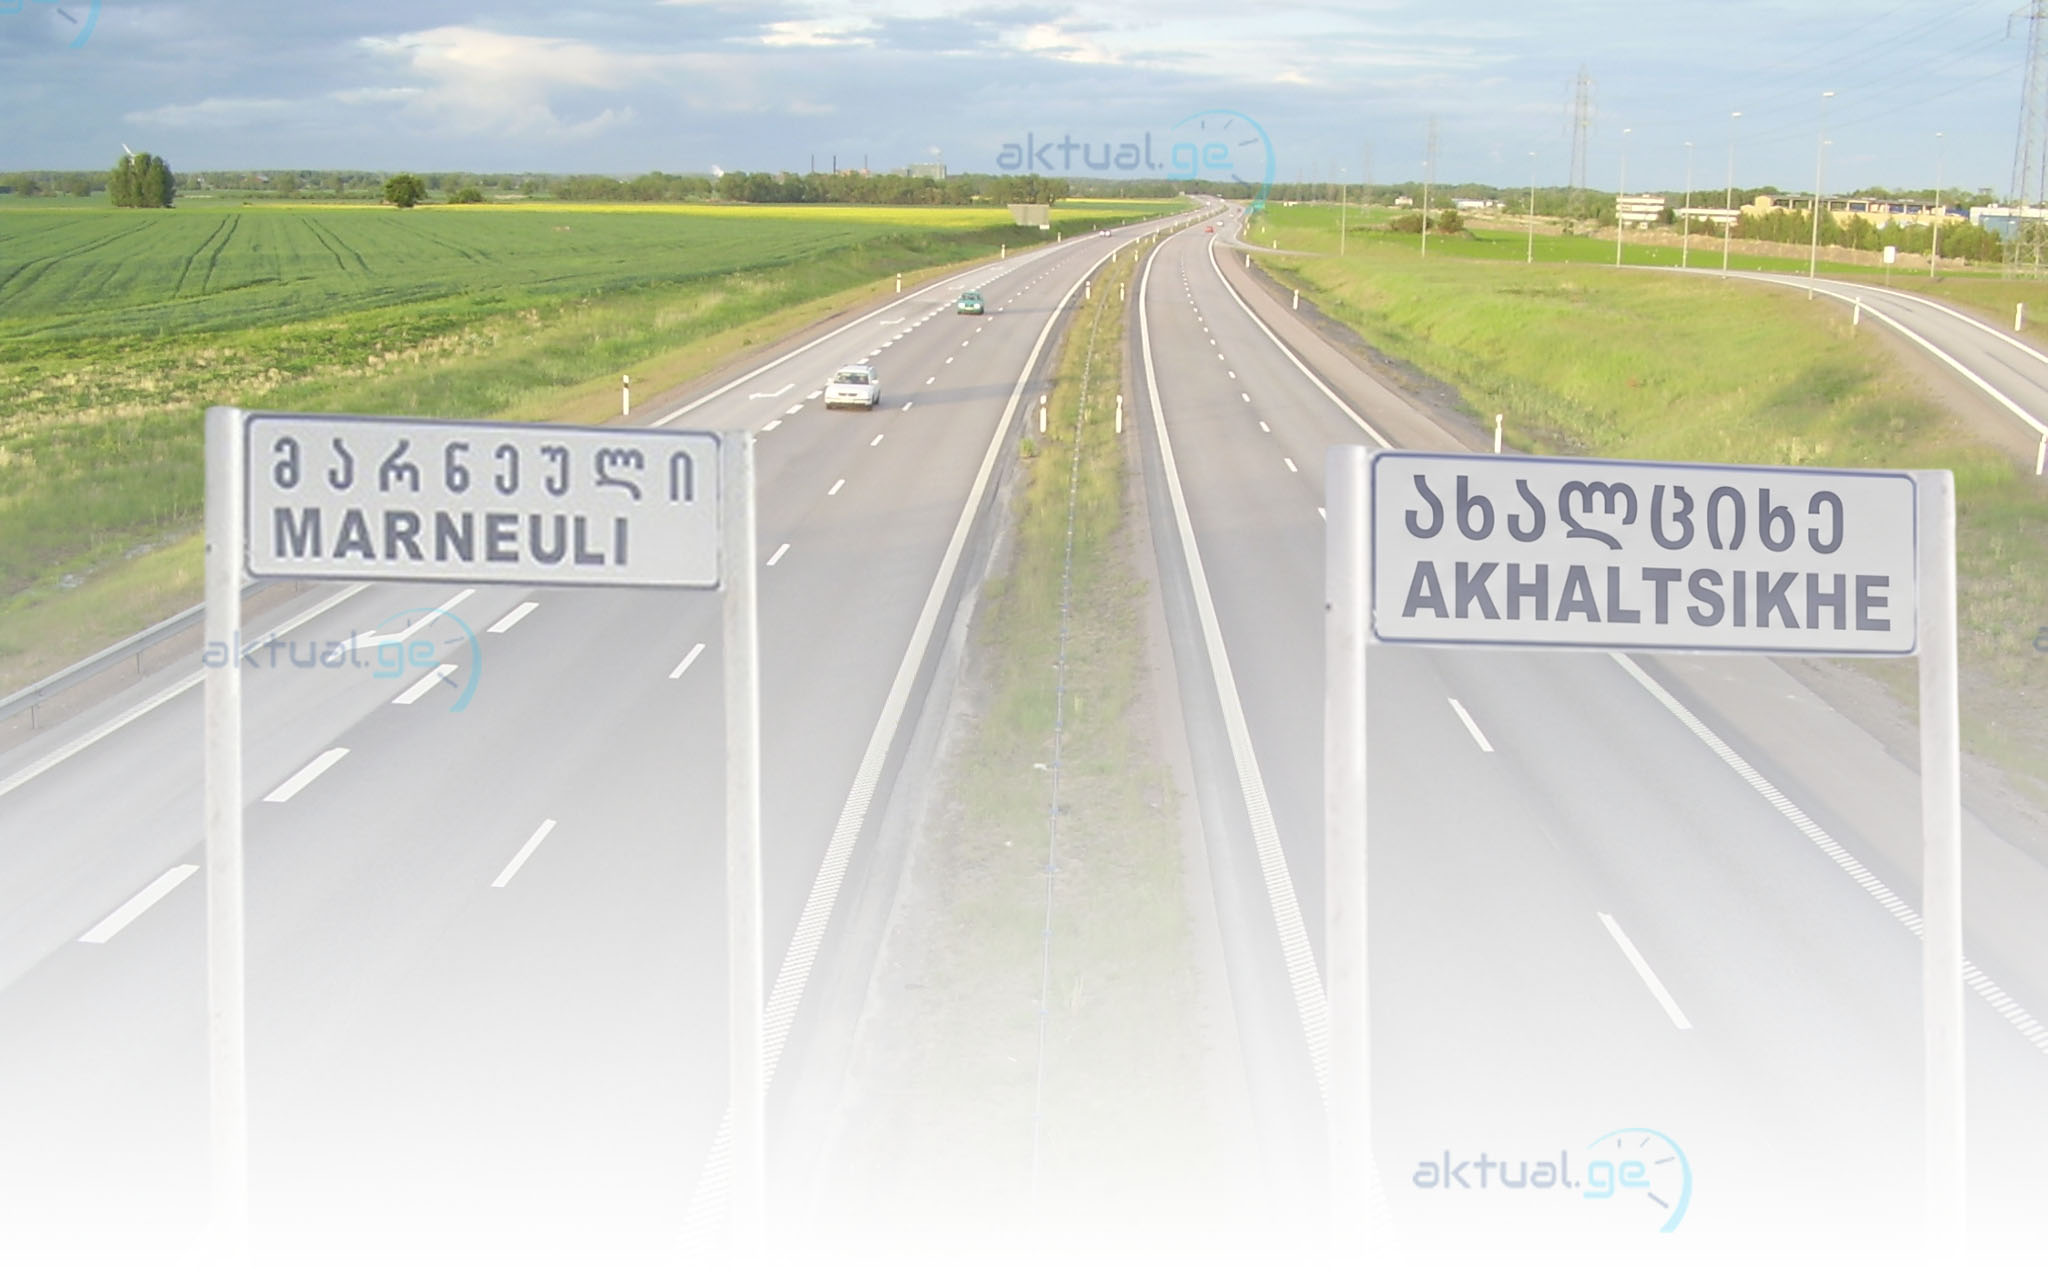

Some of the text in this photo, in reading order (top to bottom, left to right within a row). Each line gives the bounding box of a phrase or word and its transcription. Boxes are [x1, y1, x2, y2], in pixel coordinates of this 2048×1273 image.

[273, 436, 694, 503] მარნეული
[273, 507, 629, 567] MARNEULI
[1404, 474, 1845, 555] ახალციხე
[1401, 560, 1892, 633] AKHALTSIKHE
